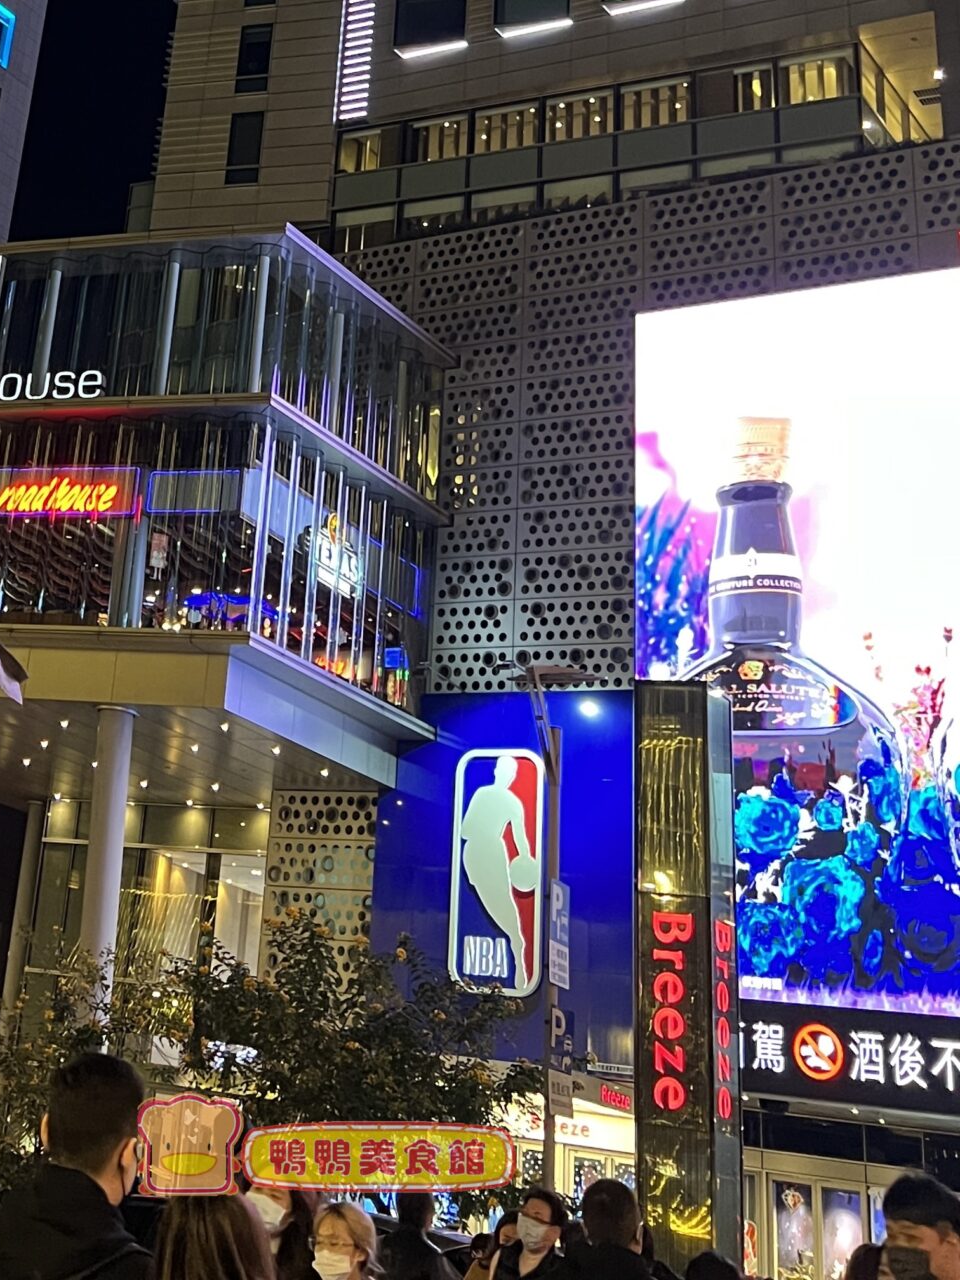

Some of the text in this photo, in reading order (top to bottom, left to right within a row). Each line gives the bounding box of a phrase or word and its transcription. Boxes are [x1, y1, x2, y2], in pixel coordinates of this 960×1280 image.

[552, 883, 564, 922] P
[462, 935, 509, 979] NBA
[551, 1007, 567, 1048] P
[652, 911, 695, 1111] Breeze
[714, 920, 733, 1119] Breeze
[739, 1020, 785, 1073] 駕
[601, 1084, 631, 1110] Breeze
